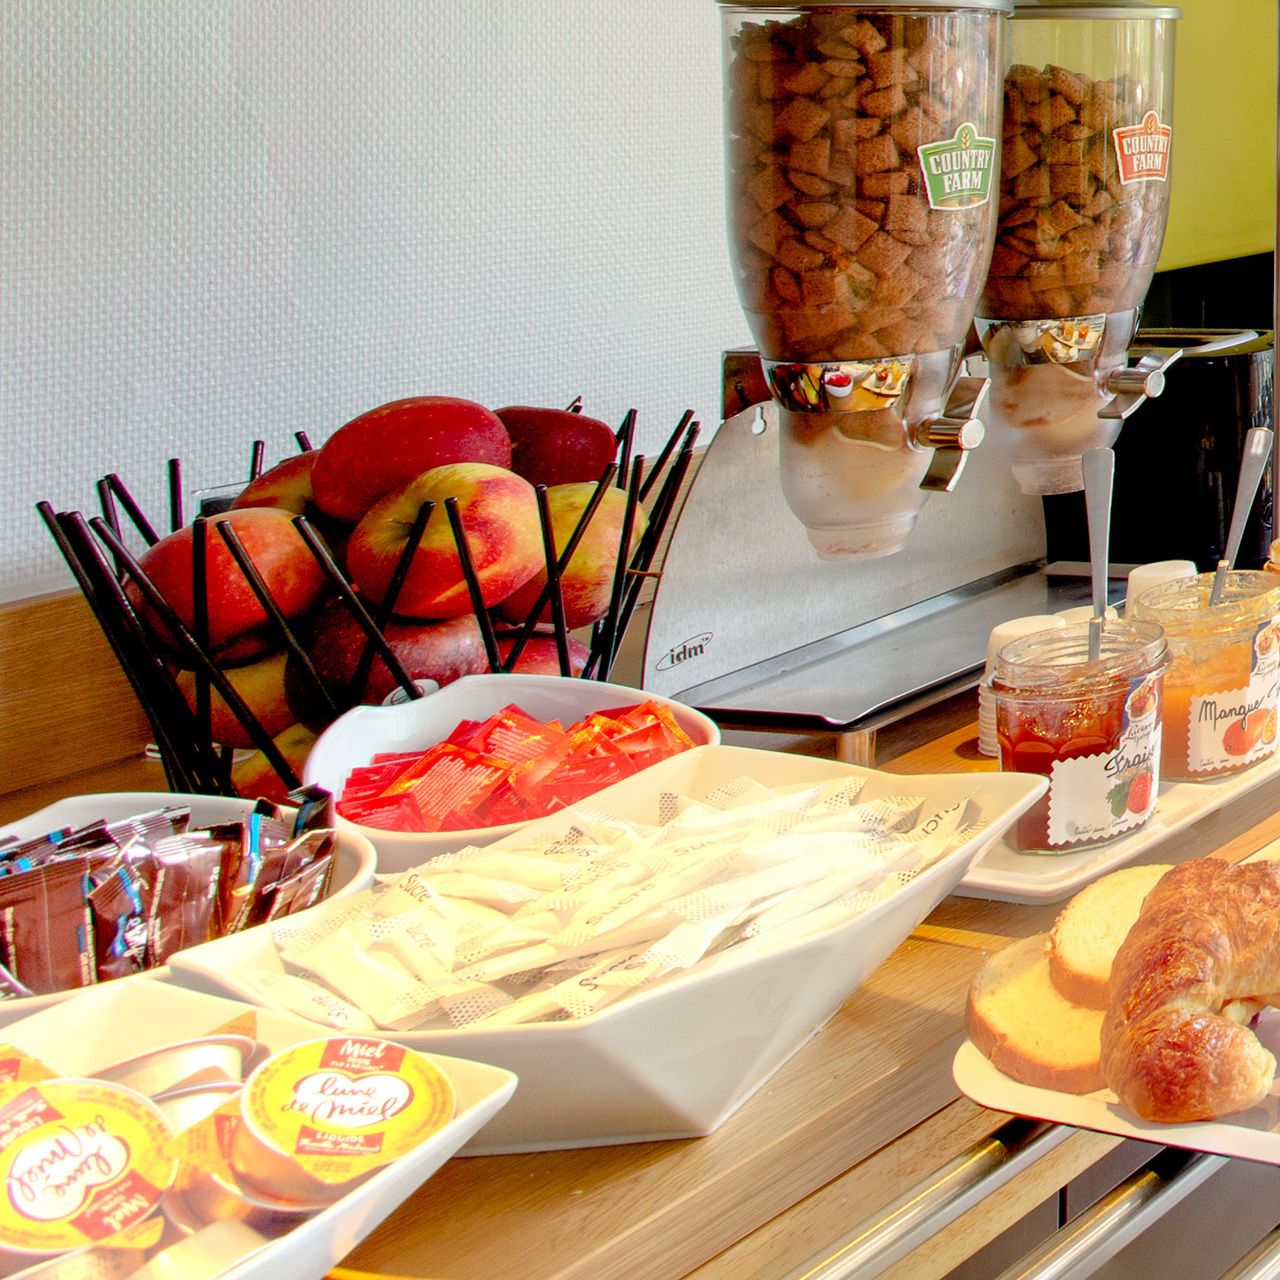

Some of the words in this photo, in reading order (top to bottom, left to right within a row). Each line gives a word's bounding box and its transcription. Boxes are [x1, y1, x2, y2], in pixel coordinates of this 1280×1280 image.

[1121, 135, 1170, 156] COUNTRY
[928, 149, 991, 175] COUNTRY
[1132, 153, 1162, 172] FARM
[942, 171, 982, 194] FARM
[669, 643, 705, 665] idm
[1199, 696, 1265, 732] Mangue
[399, 873, 432, 903] Sucre
[339, 1039, 386, 1059] Miel
[313, 1076, 377, 1099] lune
[281, 1099, 309, 1113] de
[312, 1097, 398, 1124] miel
[42, 1144, 112, 1197] lune
[102, 1193, 150, 1232] Miel
